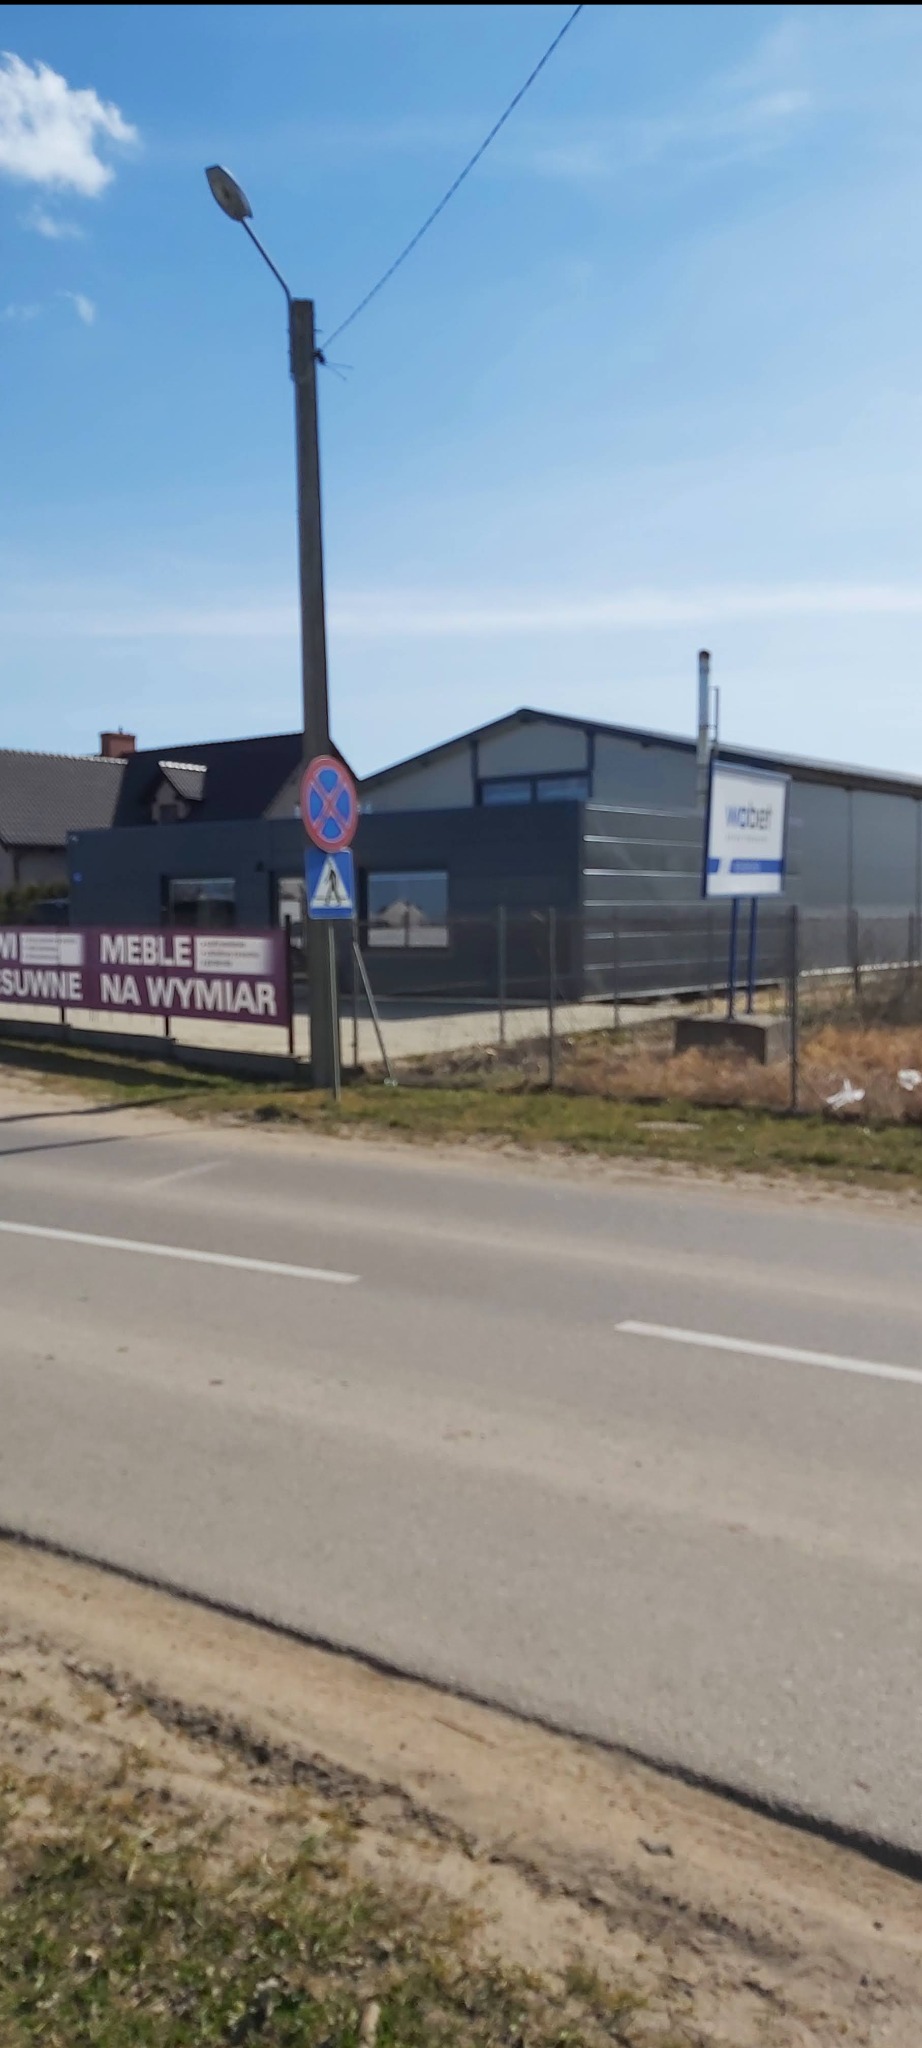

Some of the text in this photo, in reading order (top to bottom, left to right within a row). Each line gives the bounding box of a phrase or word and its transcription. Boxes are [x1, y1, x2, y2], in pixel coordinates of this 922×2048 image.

[101, 934, 194, 967] MEBLE
[0, 967, 83, 1000] SUWNE
[101, 974, 277, 1016] NA WYMIAR
